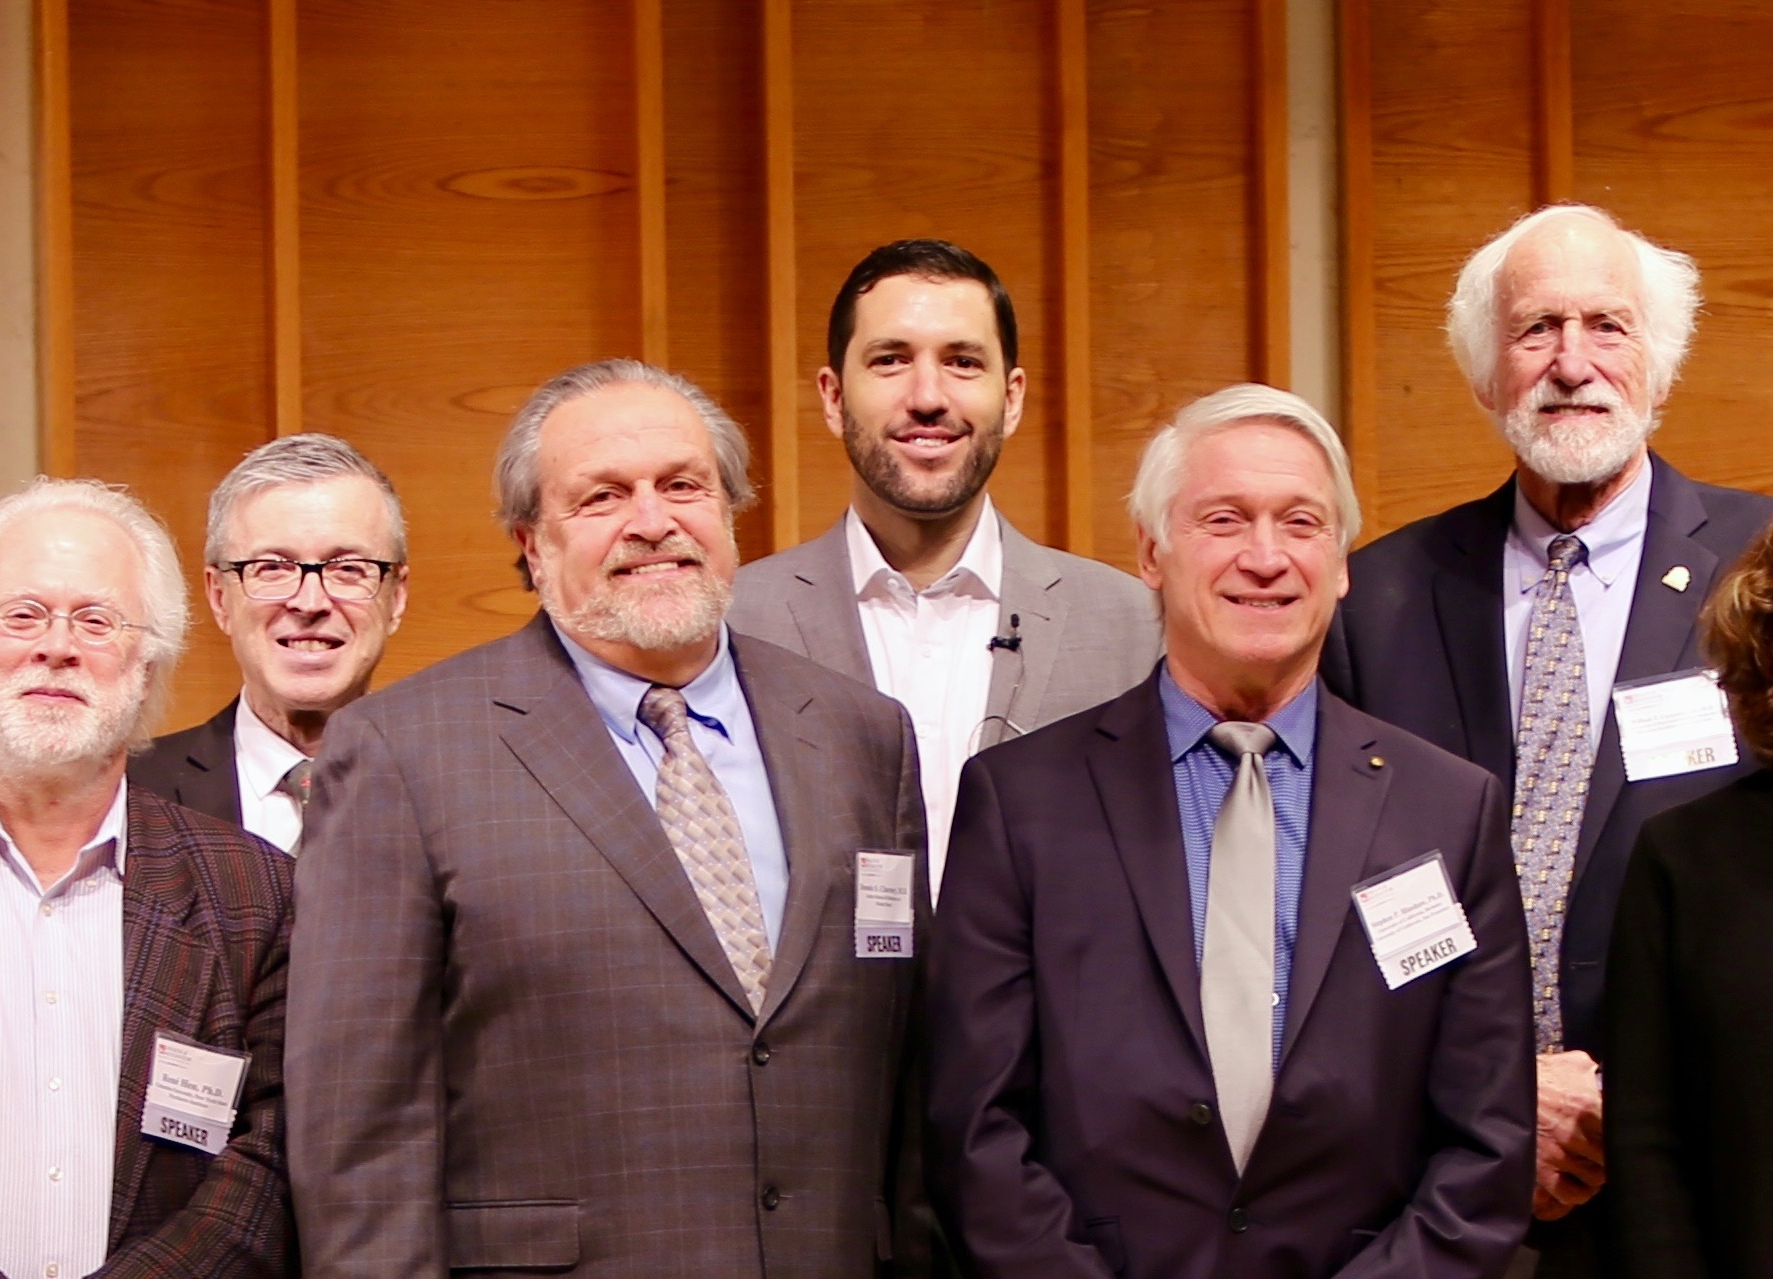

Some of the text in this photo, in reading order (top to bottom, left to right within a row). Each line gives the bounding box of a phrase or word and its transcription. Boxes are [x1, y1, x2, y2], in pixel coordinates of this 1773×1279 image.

[867, 935, 902, 953] SPEAKER
[1400, 937, 1458, 976] SPEAKER
[160, 1116, 209, 1147] SPEAKER
